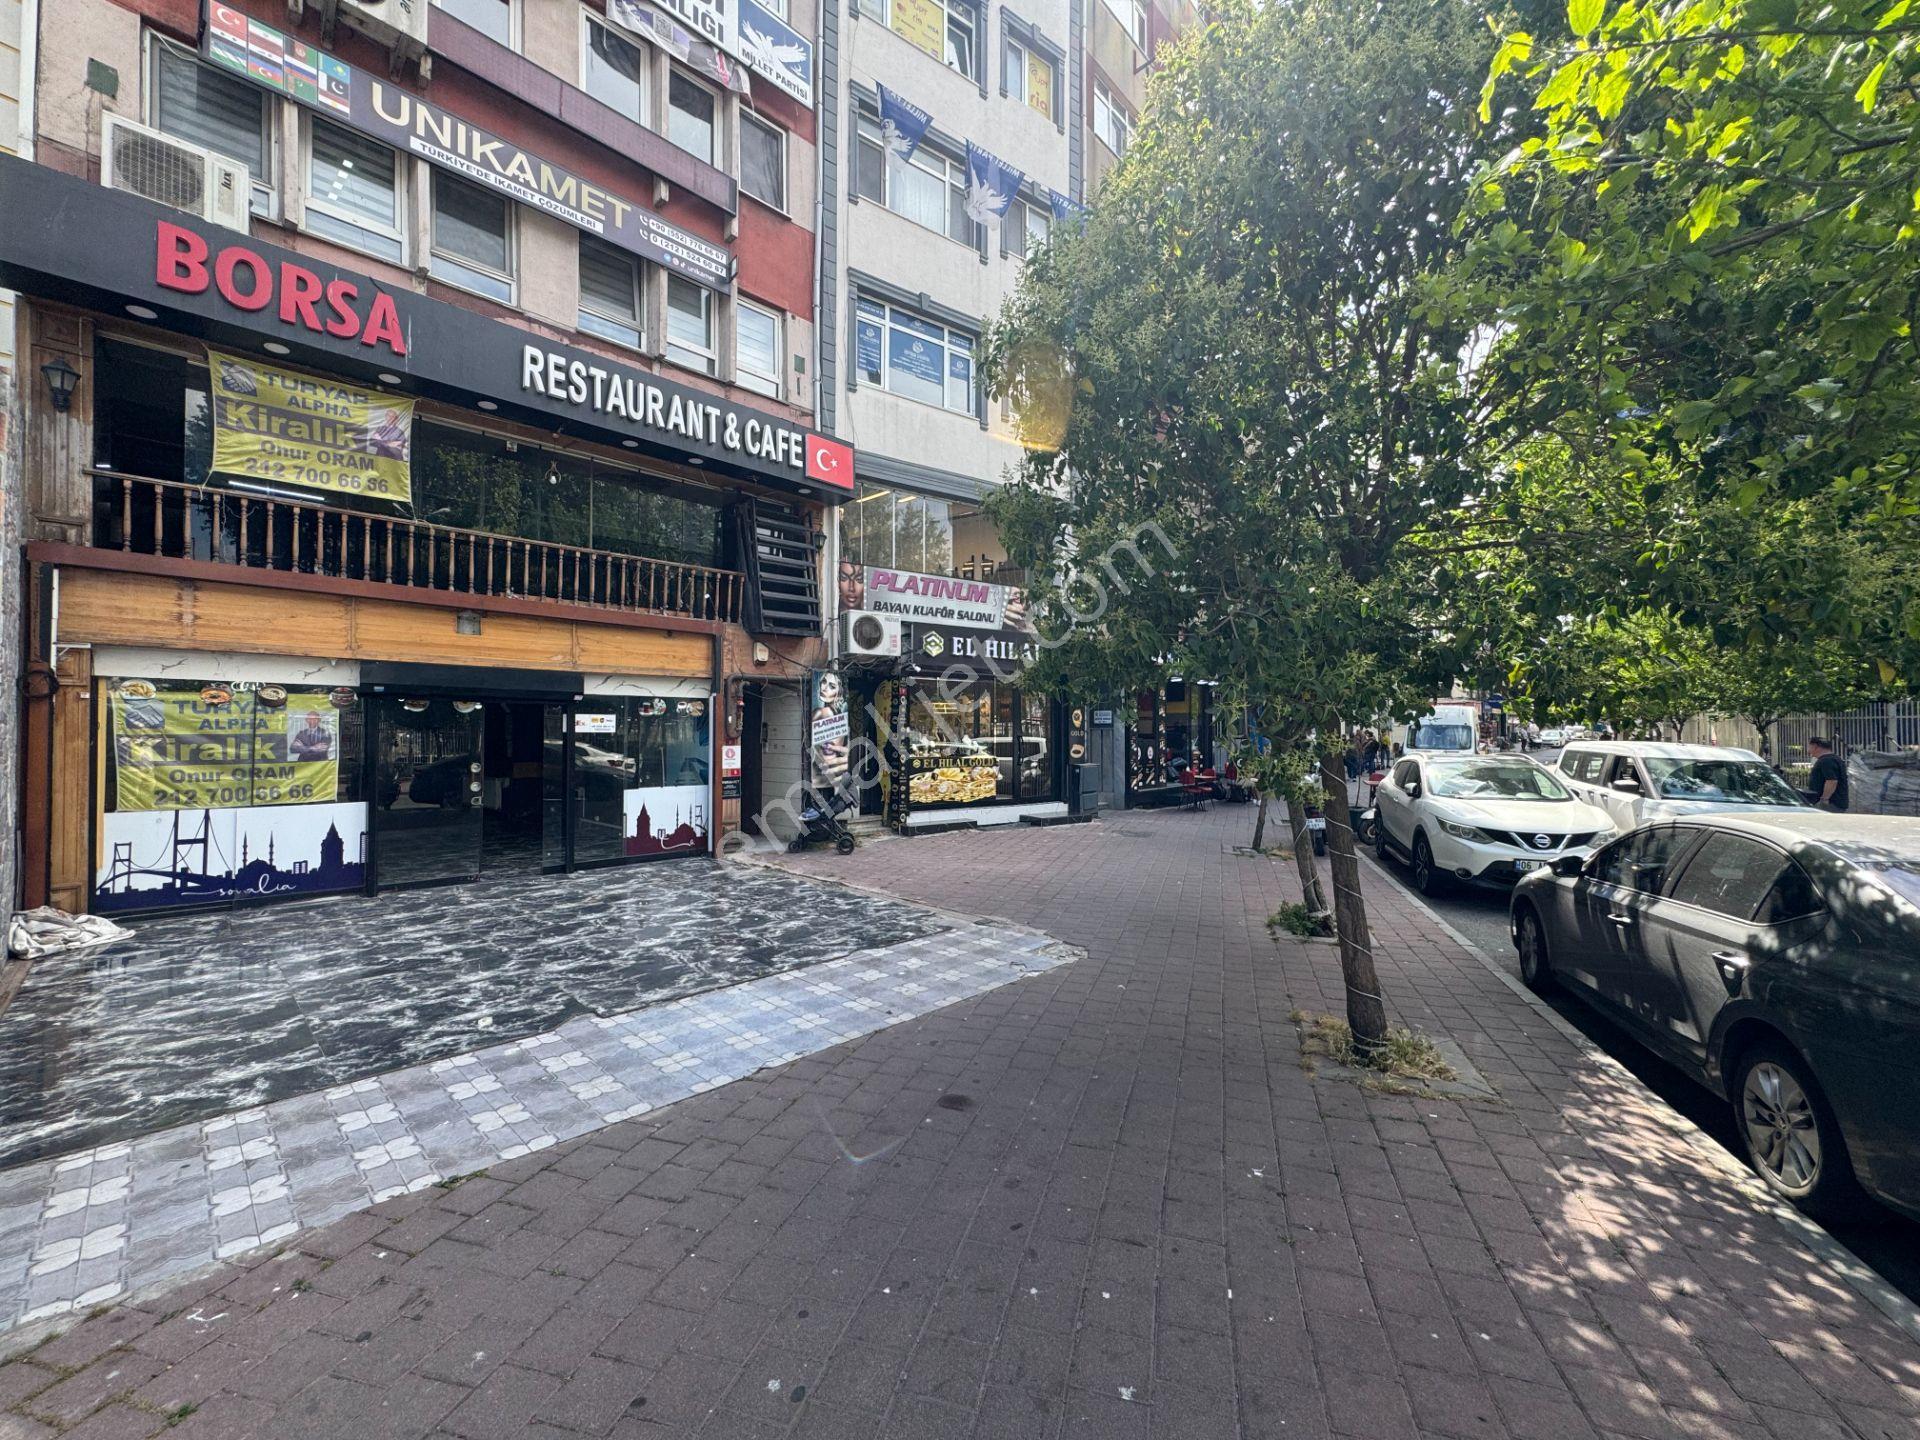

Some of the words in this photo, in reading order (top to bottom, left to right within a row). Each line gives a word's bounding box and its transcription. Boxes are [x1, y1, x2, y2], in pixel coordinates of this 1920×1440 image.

[741, 47, 775, 80] MİLLET
[775, 70, 808, 101] PARTİSİ
[371, 81, 632, 229] UNIKAMET
[420, 142, 491, 182] TÜRKİYE'DE
[494, 176, 535, 201] İKAMET
[156, 219, 408, 357] BORSA
[287, 395, 352, 418] ALPHA
[522, 344, 721, 445] RESTAURANT
[723, 411, 741, 451] &
[744, 417, 804, 468] CAFE
[226, 400, 357, 449] Kiralık
[260, 440, 310, 461] Onur
[317, 451, 374, 471] ORAM
[245, 457, 286, 478] 212
[293, 465, 330, 484] 700
[338, 473, 361, 489] 66
[870, 569, 990, 604] PLATINUM
[873, 600, 911, 614] BAYAN
[913, 605, 955, 620] KUAFÖR
[956, 609, 996, 624] SALONU
[952, 636, 977, 658] EL
[198, 718, 268, 730] ALPHA
[814, 715, 845, 729] PLATINUM
[169, 769, 222, 784] Onur
[232, 766, 295, 781] ORAM
[924, 758, 937, 768] EL
[939, 758, 968, 767] HILAL
[969, 757, 994, 767] GOLD
[154, 789, 197, 805] 212
[206, 787, 247, 802] 700
[256, 785, 281, 800] 66
[288, 784, 313, 799] 66
[1521, 861, 1531, 869] 06
